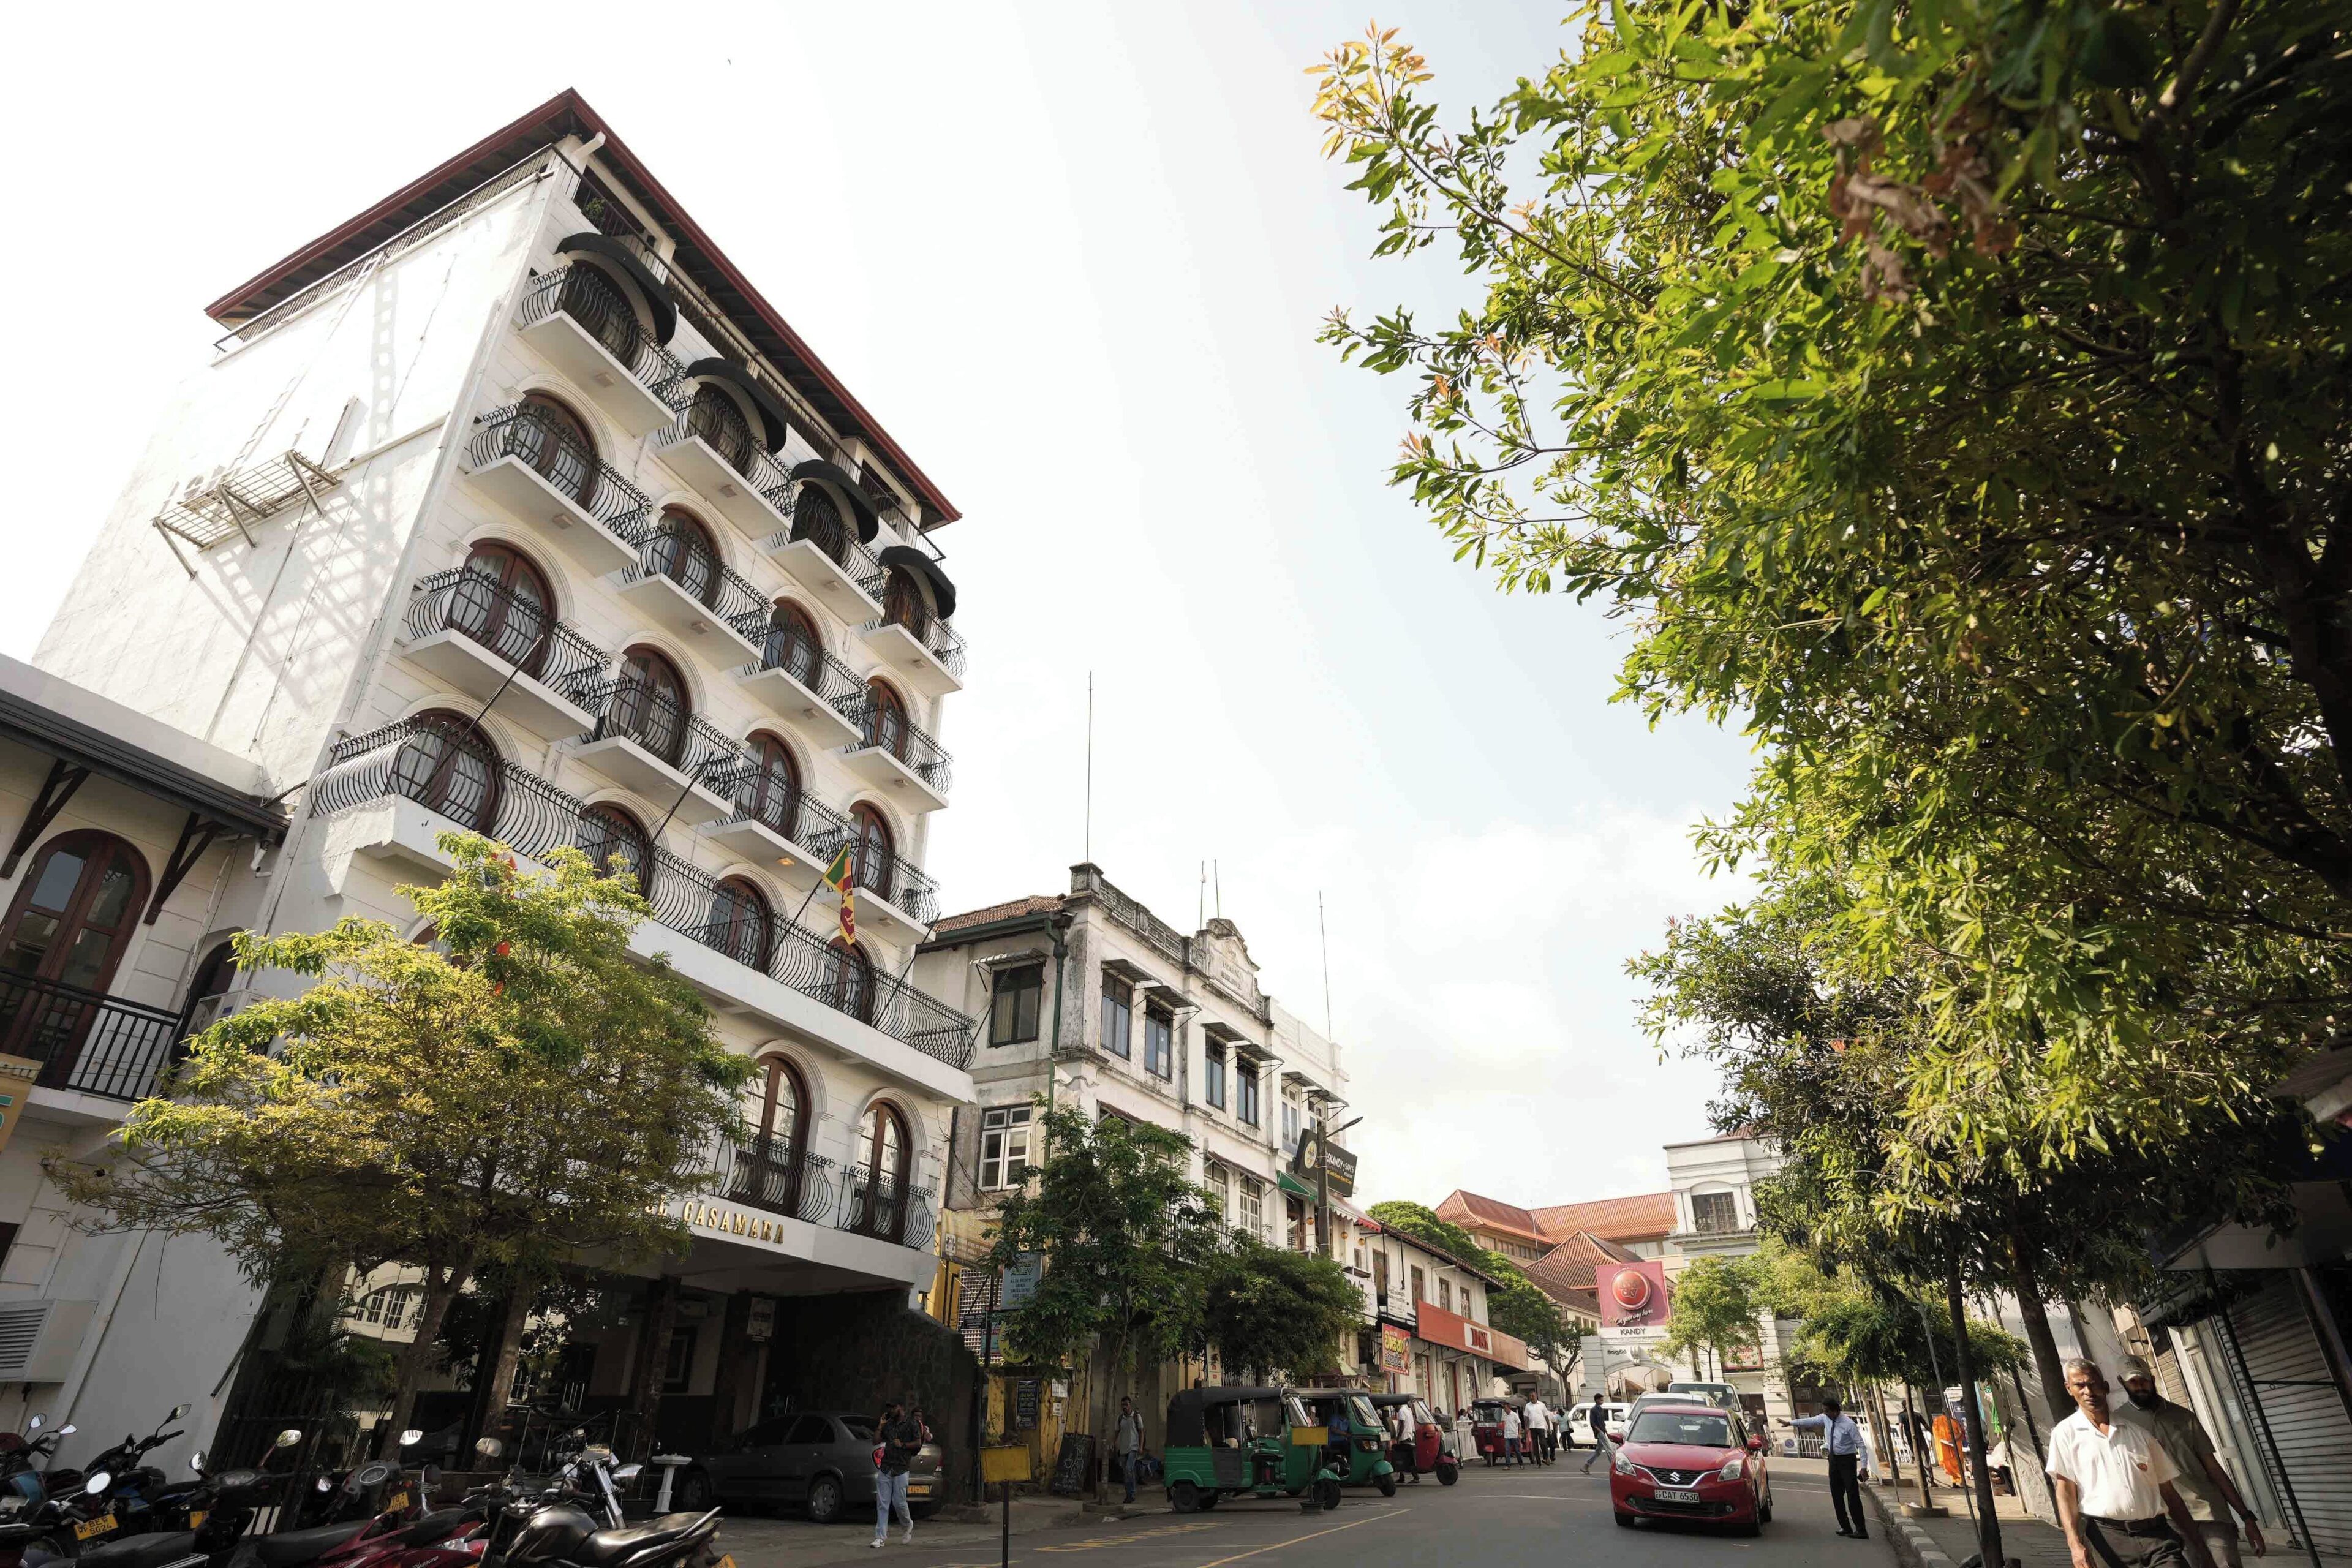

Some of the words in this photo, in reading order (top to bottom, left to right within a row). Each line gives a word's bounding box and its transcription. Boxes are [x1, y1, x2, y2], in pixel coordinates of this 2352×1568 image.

[1325, 1152, 1344, 1169] SKANDY
[682, 1200, 784, 1244] CASAMARA
[1662, 1491, 1677, 1499] CAT
[1680, 1493, 1698, 1501] 6530
